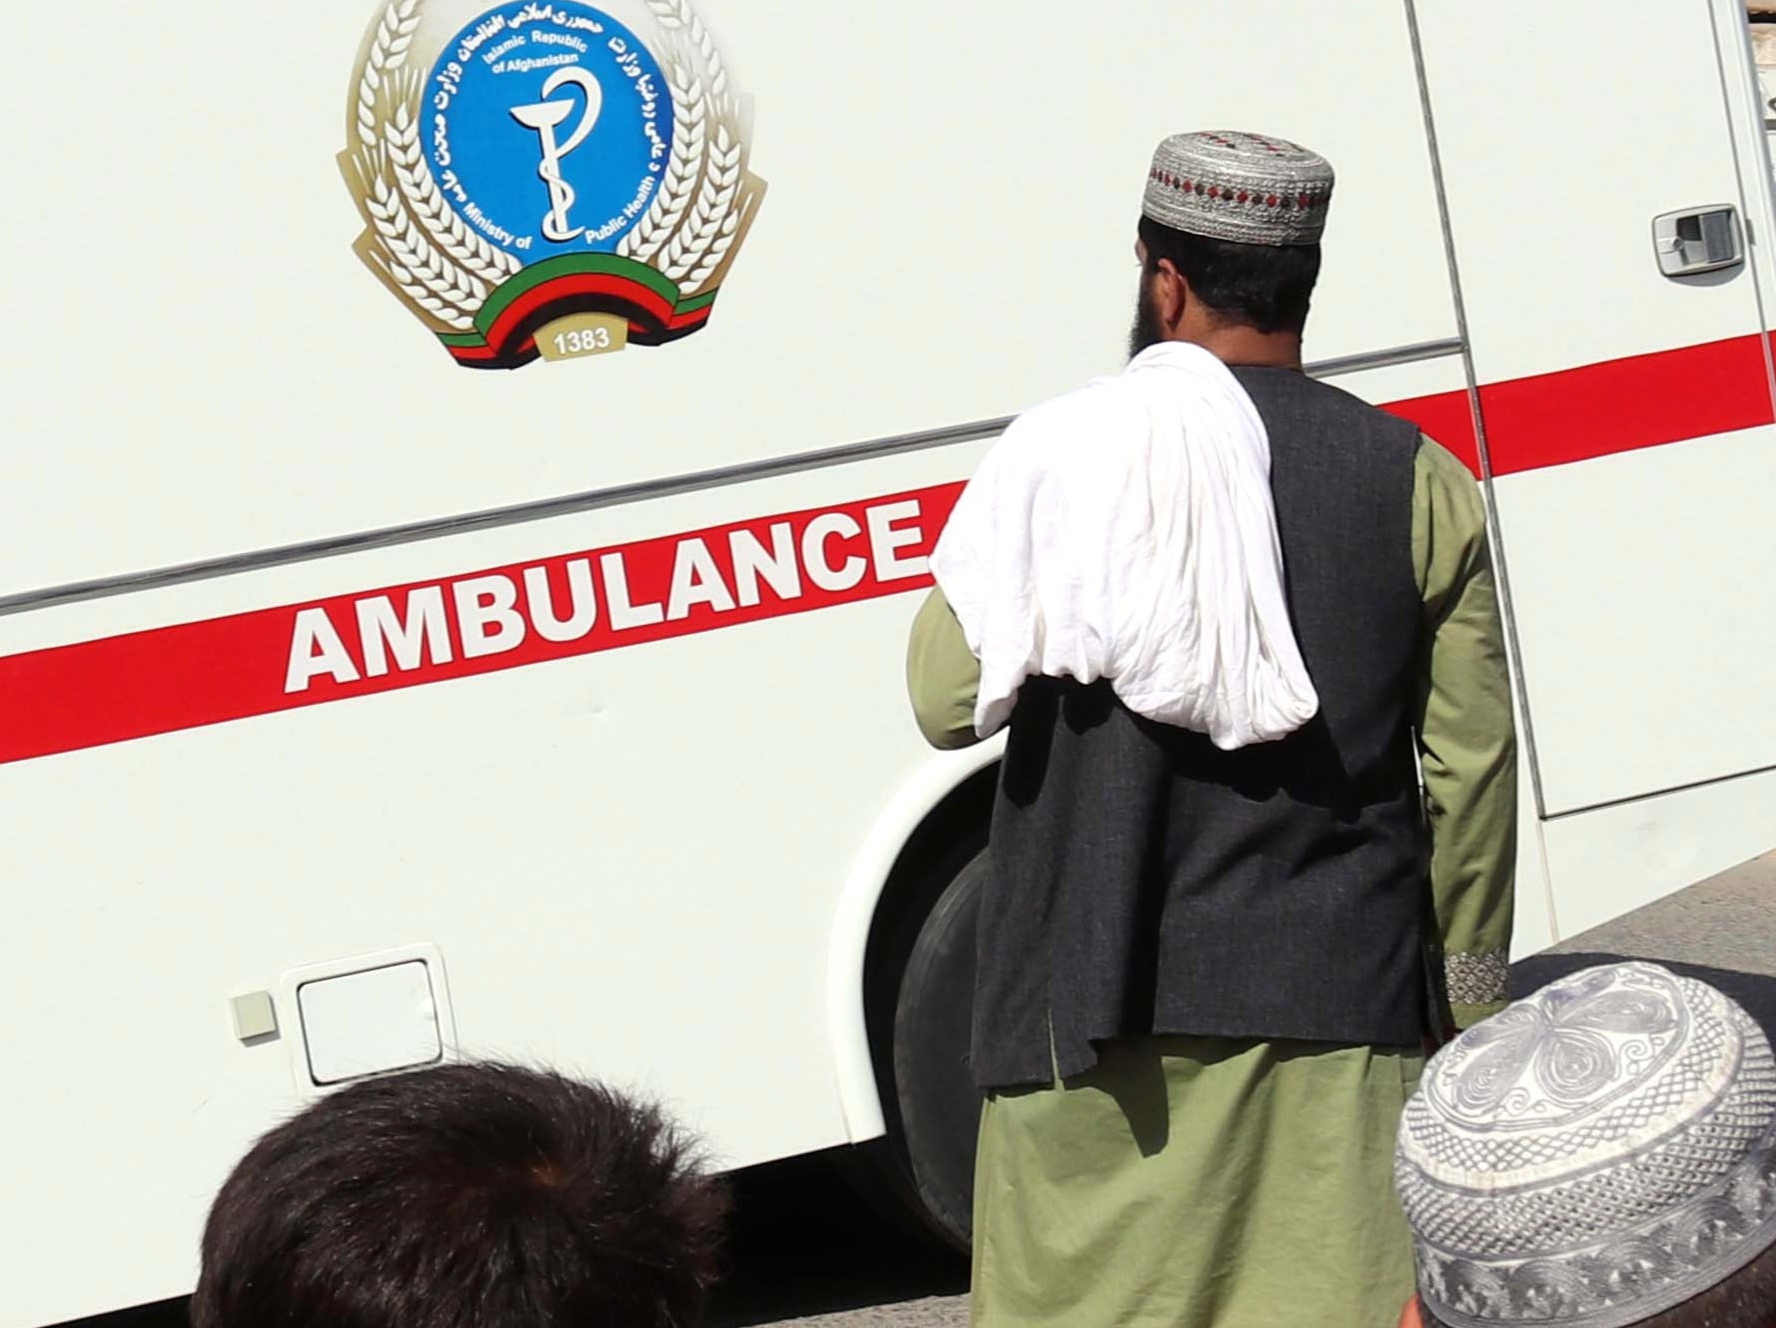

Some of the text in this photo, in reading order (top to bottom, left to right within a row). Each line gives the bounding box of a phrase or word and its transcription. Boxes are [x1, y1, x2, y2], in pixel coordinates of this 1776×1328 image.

[482, 35, 526, 64] Islamic
[492, 53, 579, 74] of Afghanistan
[463, 202, 533, 249] Ministry of
[585, 176, 656, 244] Public Health
[553, 327, 610, 354] 1383
[283, 499, 932, 695] AMBULANCE
